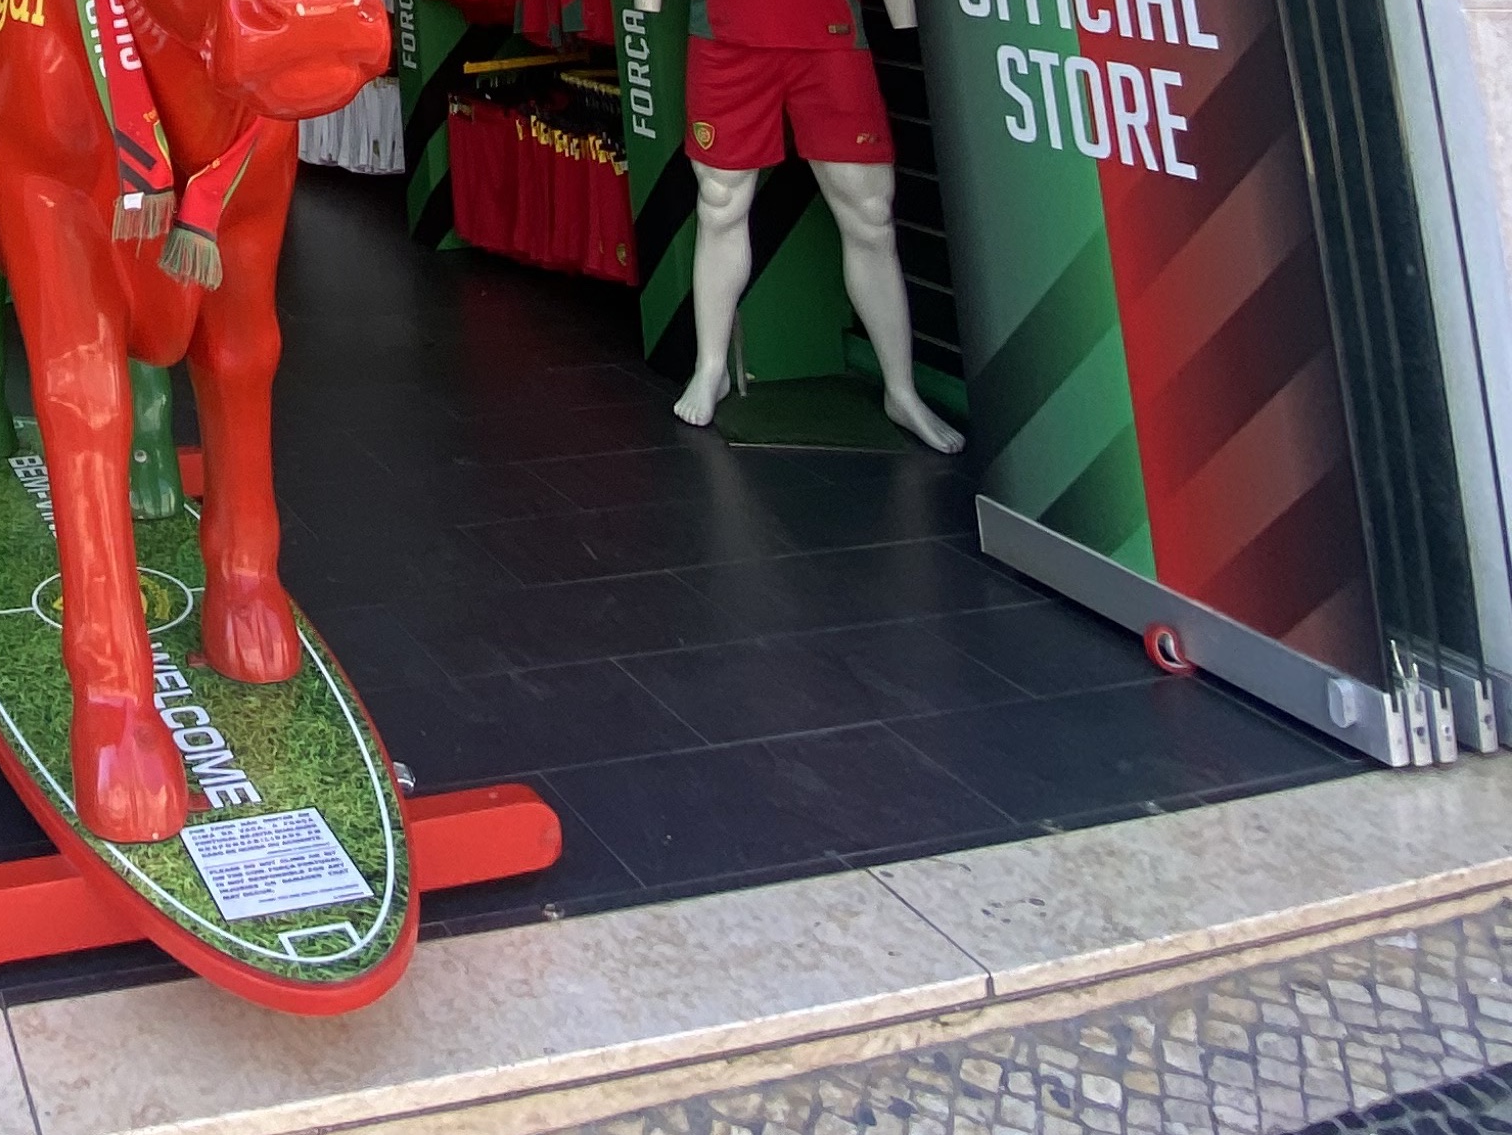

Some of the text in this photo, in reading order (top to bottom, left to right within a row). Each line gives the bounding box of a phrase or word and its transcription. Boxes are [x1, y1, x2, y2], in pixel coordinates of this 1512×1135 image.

[621, 8, 657, 140] FORÇA
[996, 44, 1198, 181] STORE
[149, 641, 263, 810] WELCOME
